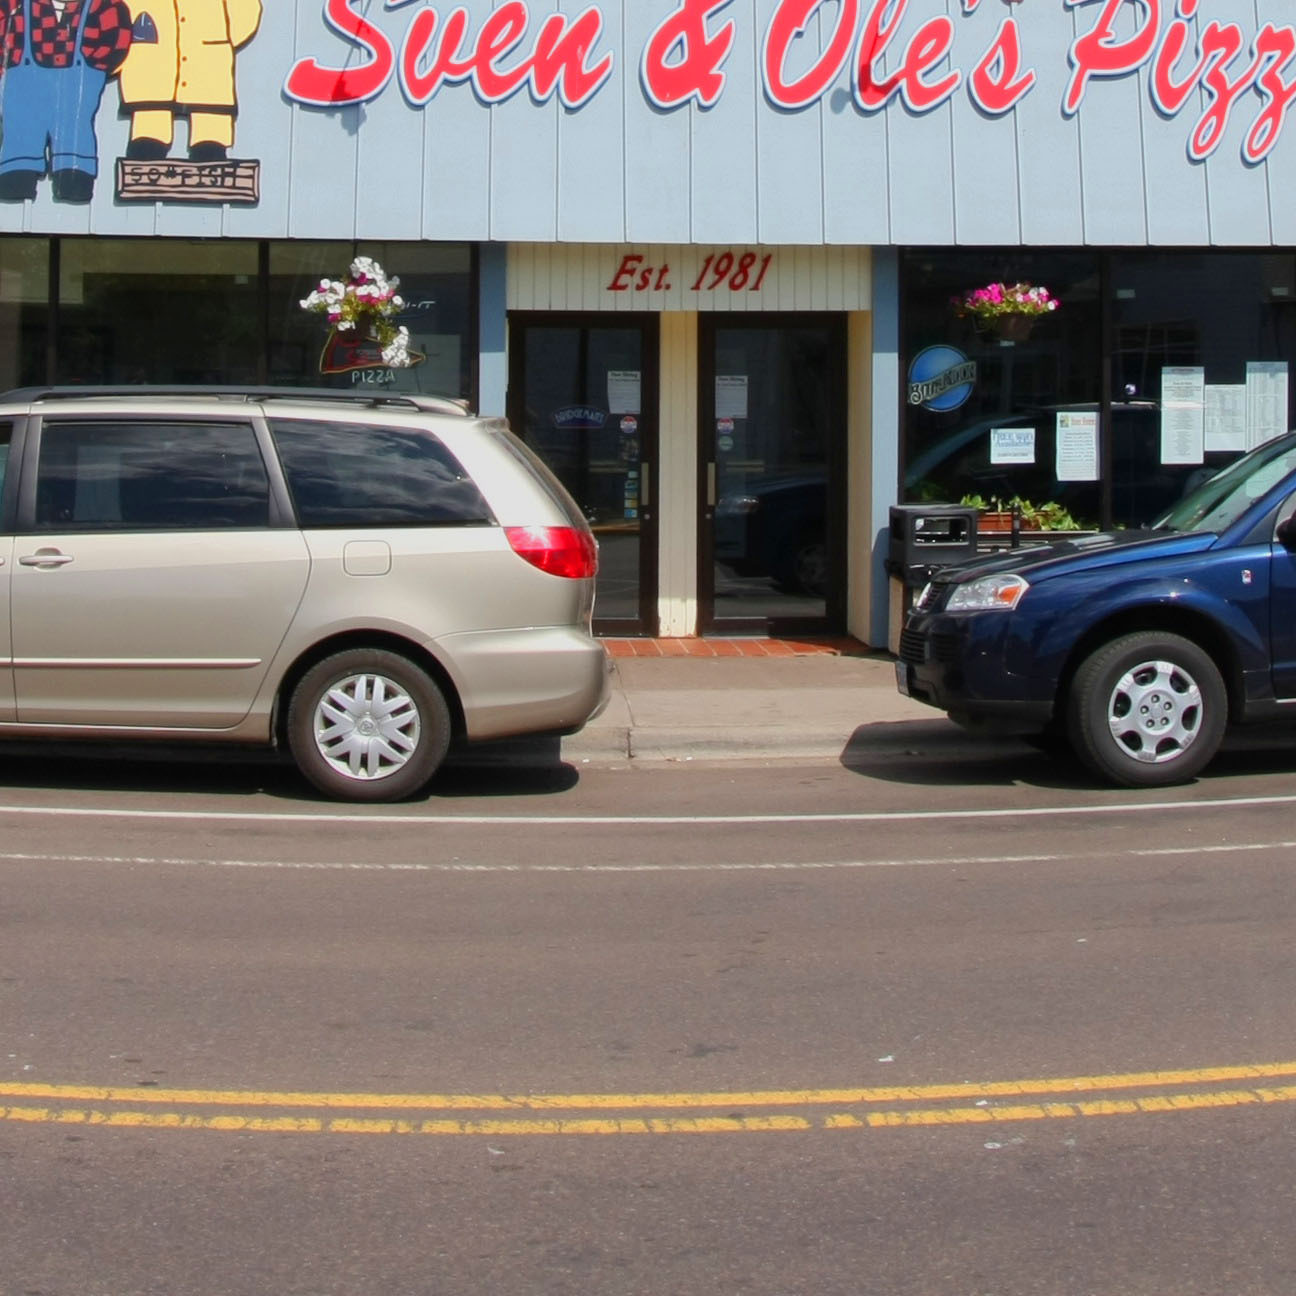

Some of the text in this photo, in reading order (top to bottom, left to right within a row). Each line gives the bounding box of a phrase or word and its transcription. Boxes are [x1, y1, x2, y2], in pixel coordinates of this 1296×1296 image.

[606, 252, 772, 292] Est. 1981
[351, 369, 396, 384] PIZZA
